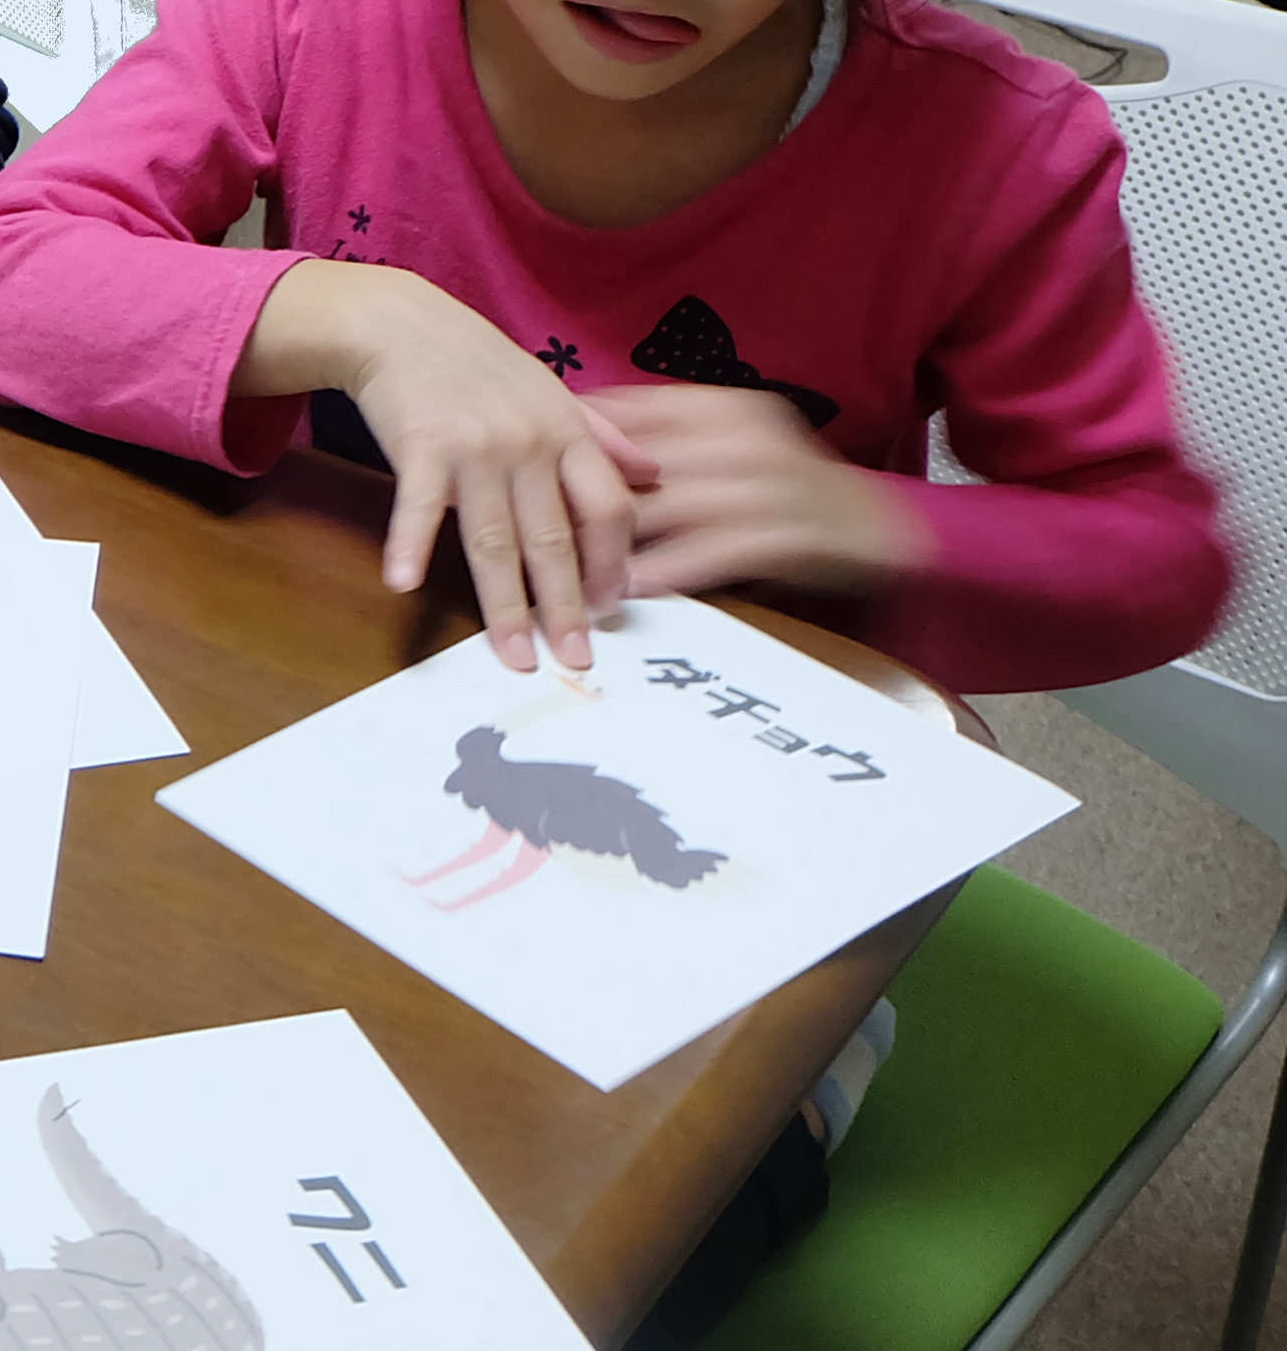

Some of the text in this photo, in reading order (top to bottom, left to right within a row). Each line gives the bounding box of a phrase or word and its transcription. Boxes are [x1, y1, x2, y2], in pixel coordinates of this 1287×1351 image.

[643, 657, 888, 782] ダチョウ
[287, 1176, 407, 1303] ワニ
